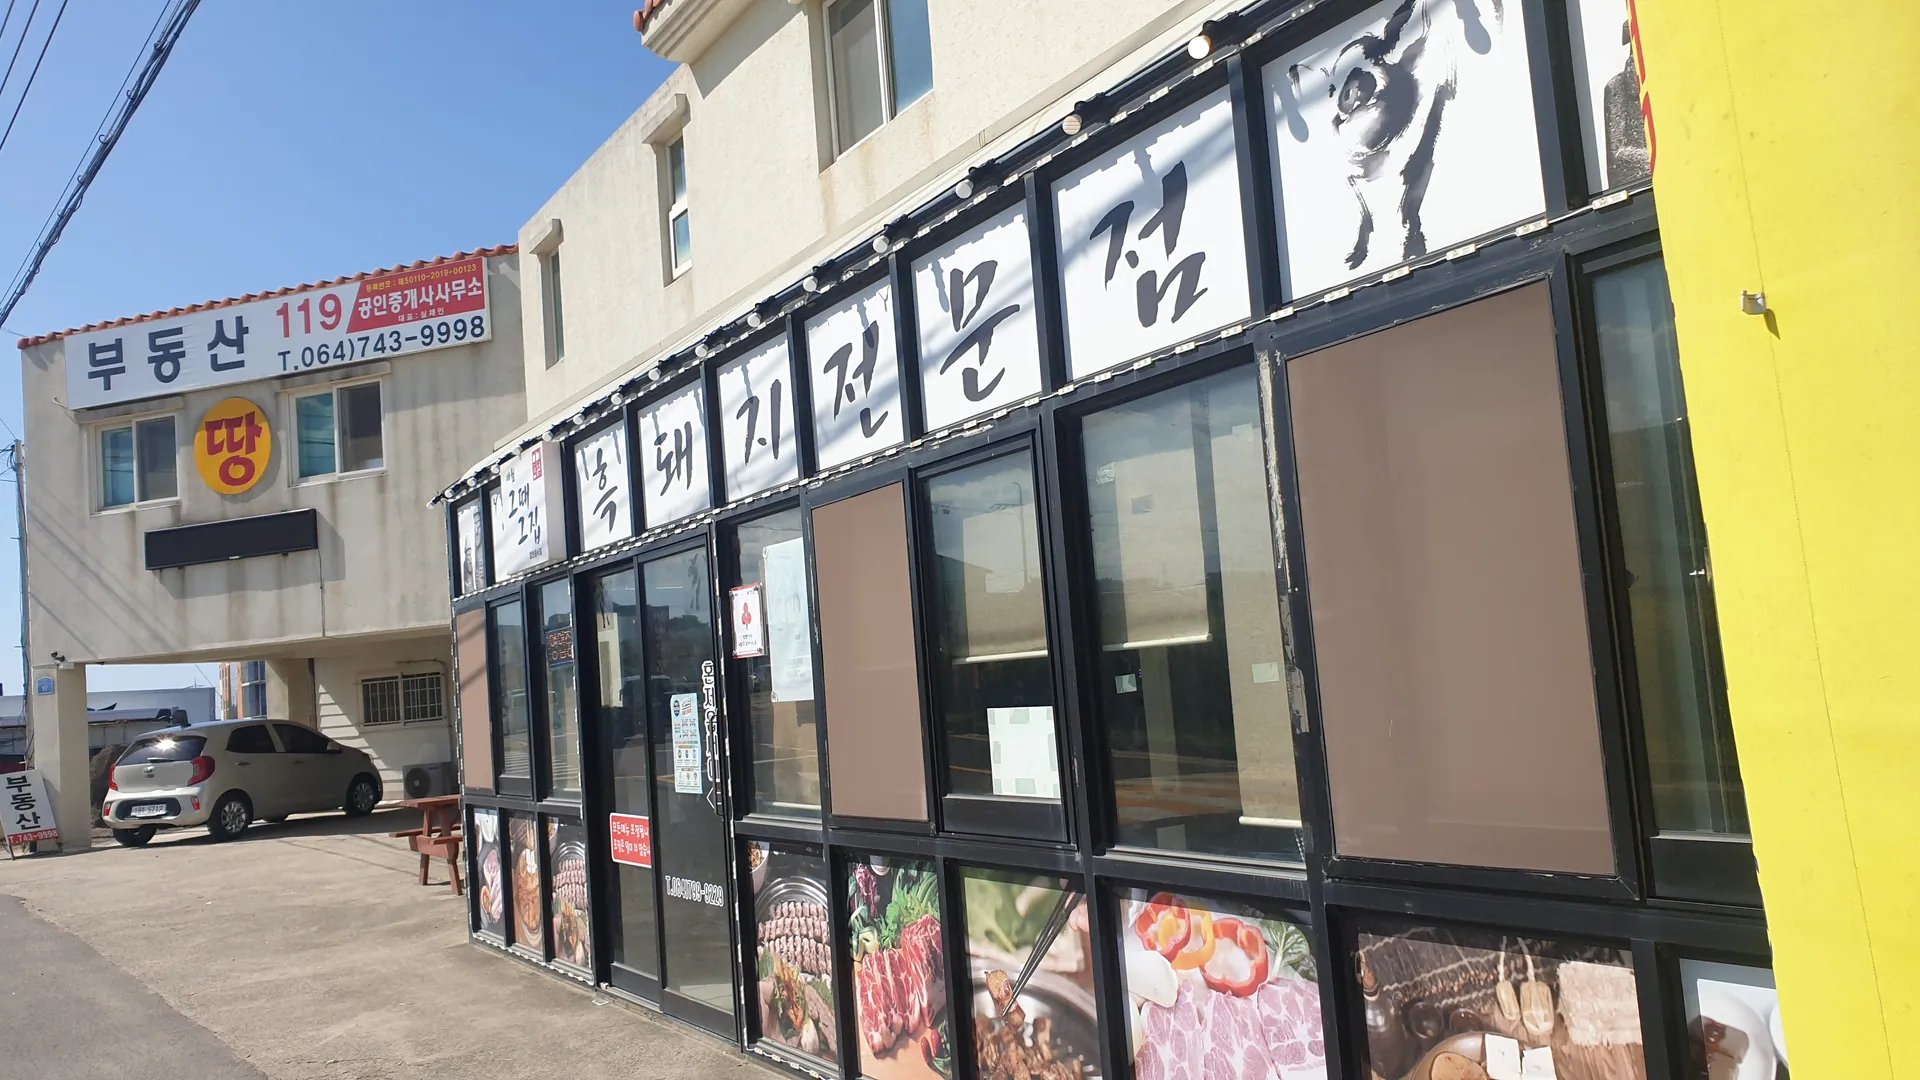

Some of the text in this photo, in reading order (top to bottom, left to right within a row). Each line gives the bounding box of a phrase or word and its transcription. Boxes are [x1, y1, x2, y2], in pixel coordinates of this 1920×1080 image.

[398, 263, 477, 286] 제50110-2019-00123
[276, 293, 342, 338] 119
[358, 276, 483, 320] 공인중개사사무소
[88, 315, 249, 391] 부동산
[278, 315, 485, 372] T.064)743-9998
[205, 410, 262, 487] 땅
[6, 776, 41, 831] 부동산
[8, 828, 58, 844] T.743-9998
[630, 823, 649, 839] 포장됩니
